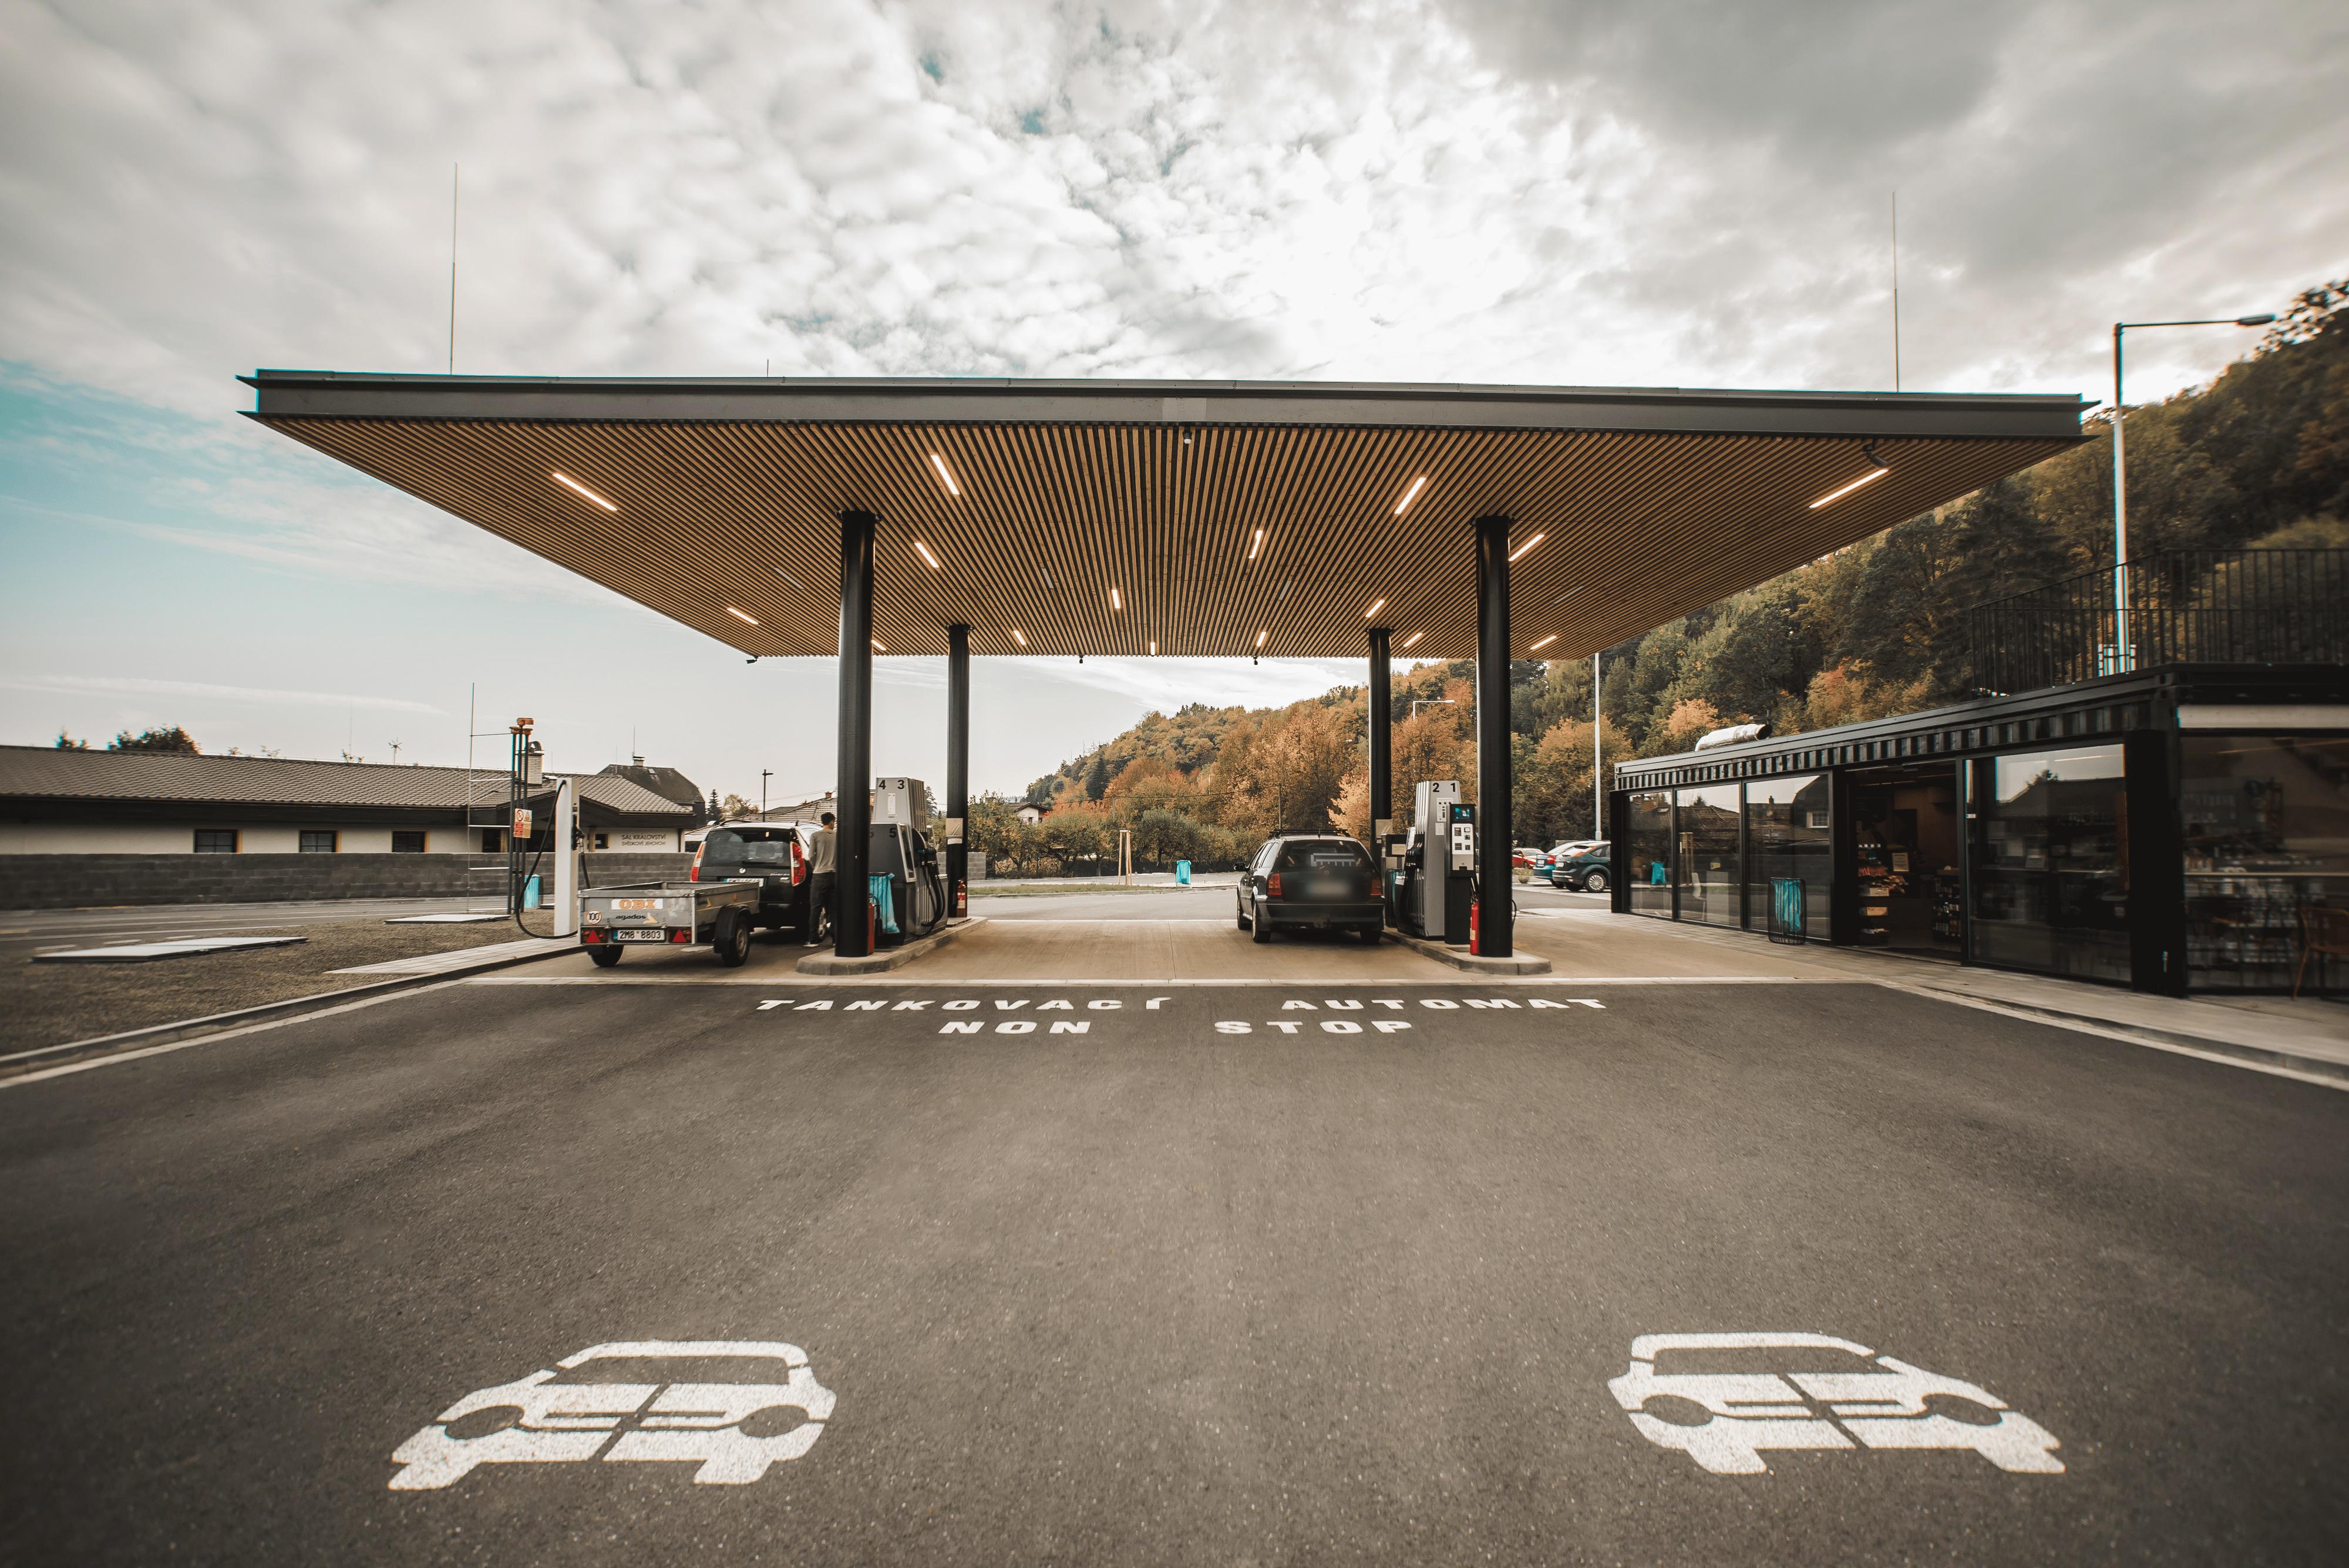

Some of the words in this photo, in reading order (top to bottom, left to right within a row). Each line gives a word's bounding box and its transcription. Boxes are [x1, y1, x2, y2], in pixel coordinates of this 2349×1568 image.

[879, 780, 886, 789] 4
[897, 780, 905, 789] 3
[1433, 783, 1439, 792] 2
[1451, 783, 1456, 792] 1
[889, 827, 897, 838] 5
[619, 899, 656, 909] OBI
[588, 912, 599, 921] 100
[641, 930, 661, 940] 8803
[755, 997, 1173, 1011] TANKOVACÍ
[1281, 998, 1607, 1010] AUTOMAT
[938, 1021, 1091, 1035] NON
[1214, 1021, 1413, 1034] STOP
